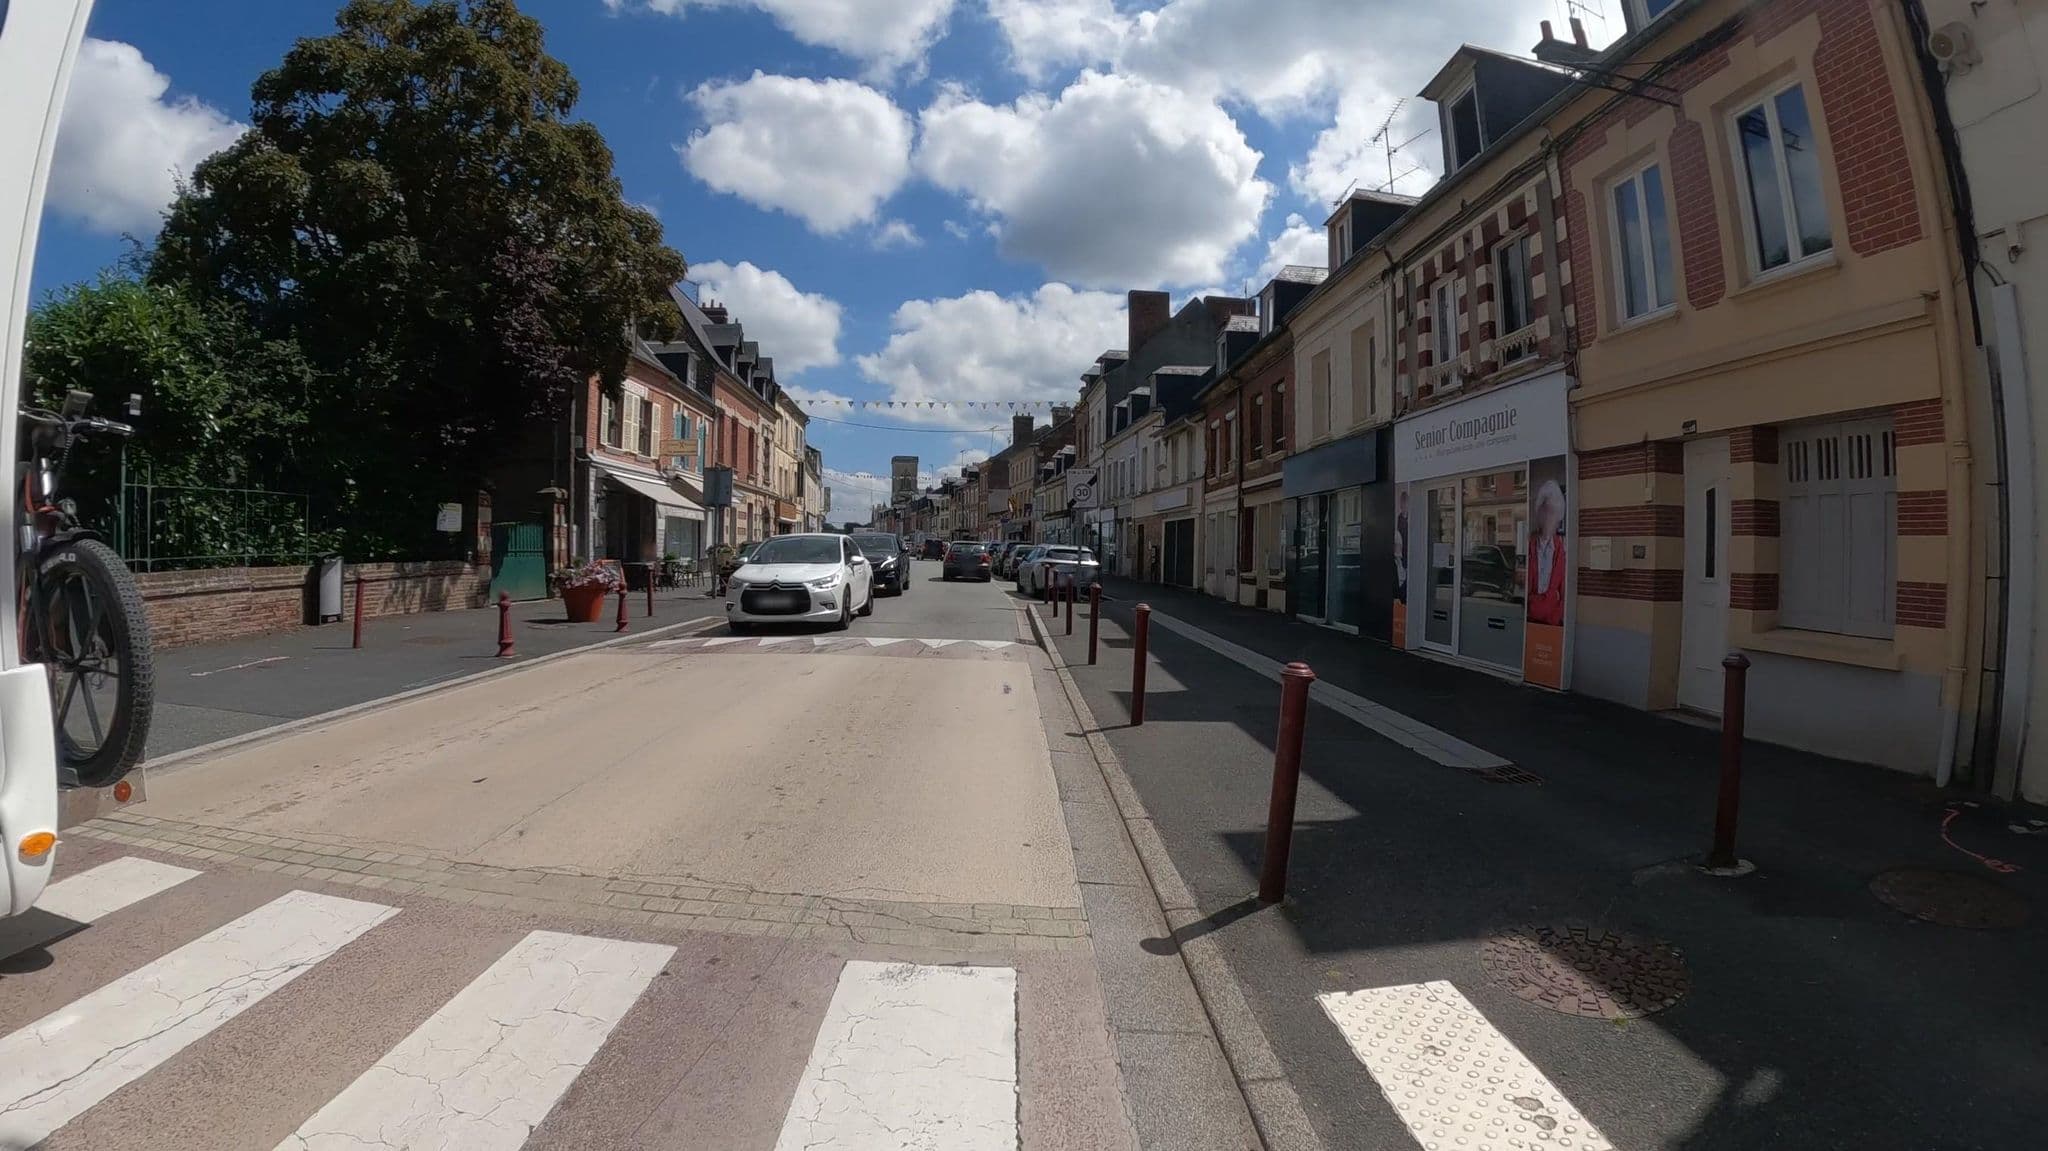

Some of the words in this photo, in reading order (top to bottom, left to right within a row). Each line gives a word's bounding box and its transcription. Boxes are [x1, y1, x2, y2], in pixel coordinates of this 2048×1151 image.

[1415, 425, 1448, 450] Senior
[1449, 403, 1517, 441] Compagnie
[1076, 488, 1089, 497] 30
